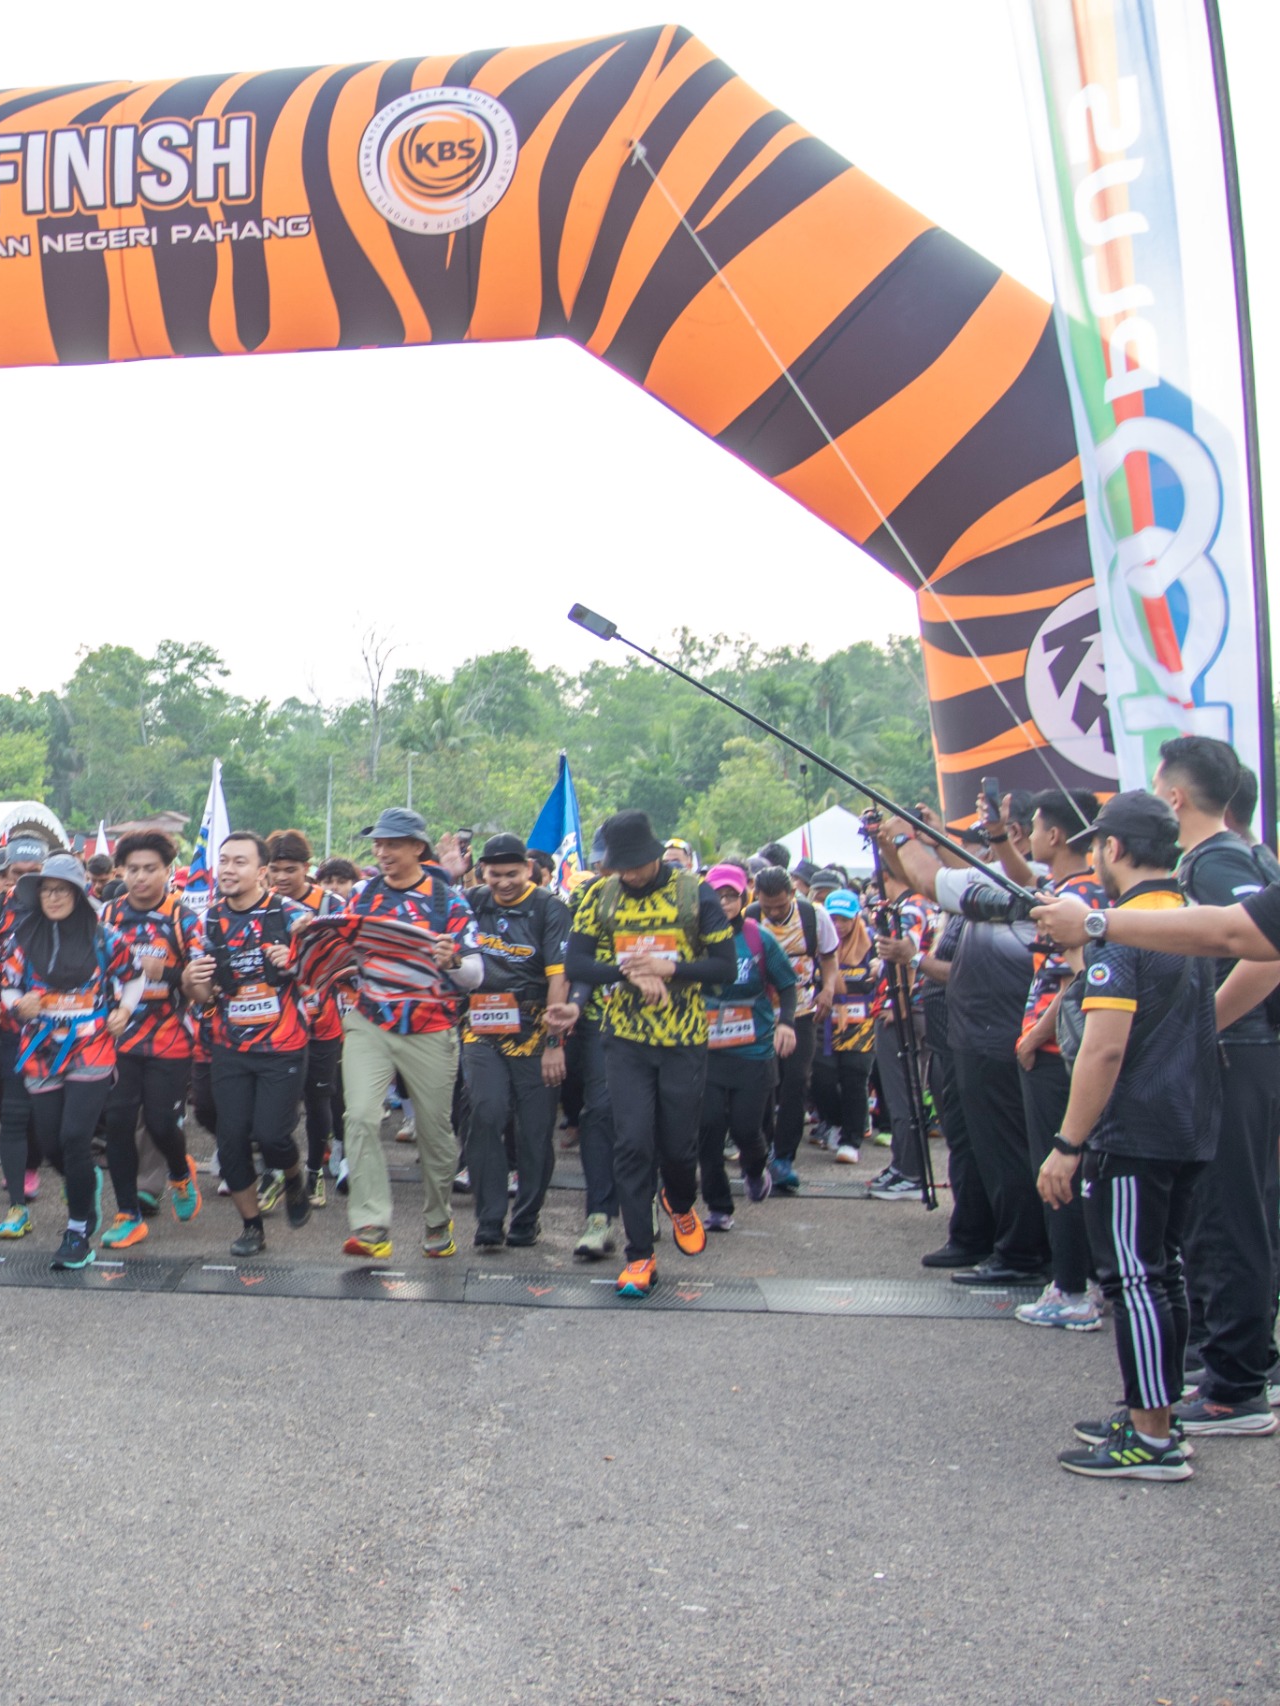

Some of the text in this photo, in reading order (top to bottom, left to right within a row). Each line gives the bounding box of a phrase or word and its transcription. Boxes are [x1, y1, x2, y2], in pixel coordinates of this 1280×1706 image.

[415, 138, 477, 169] KBS
[41, 226, 159, 254] NEGERI
[170, 214, 312, 244] PAHANG
[230, 1001, 272, 1013] D0015
[473, 1011, 510, 1021] D0101
